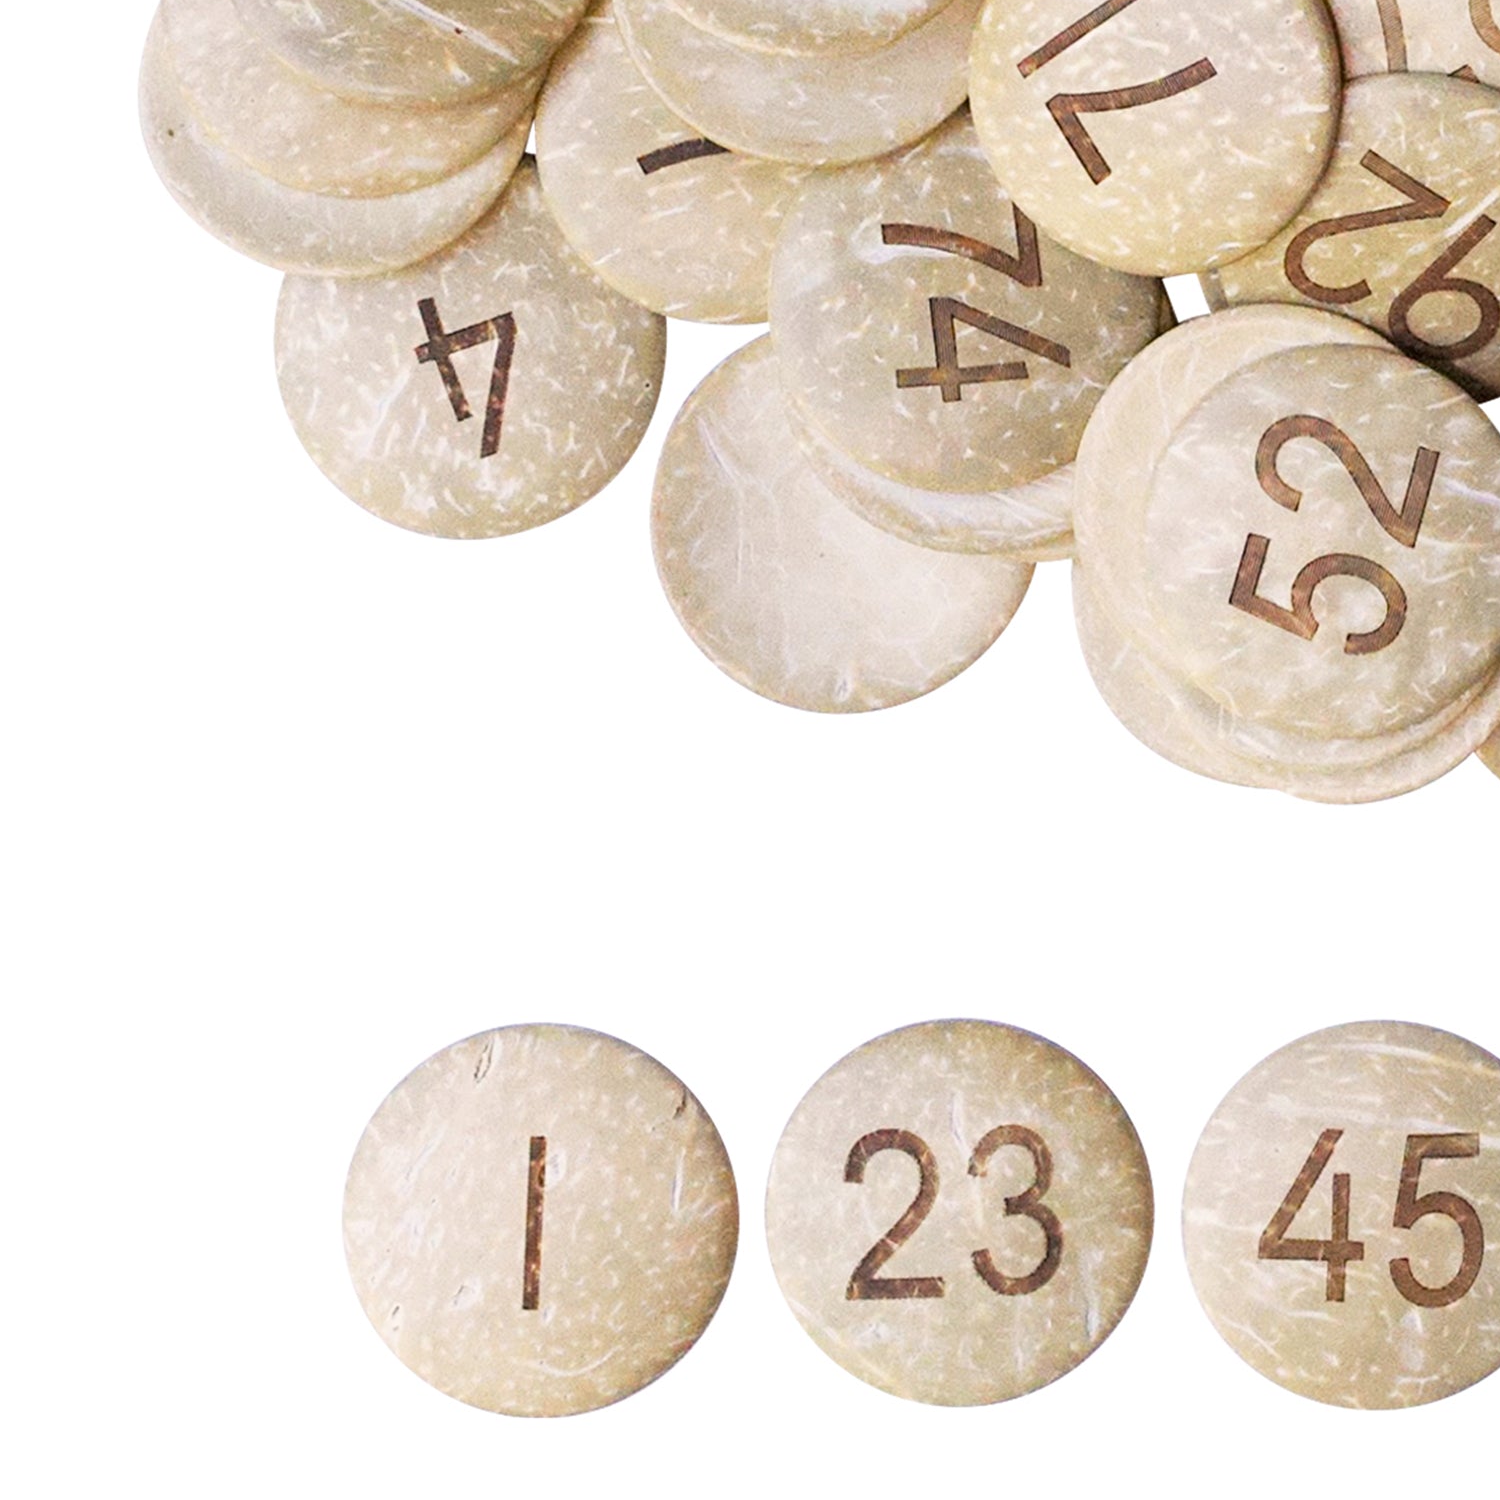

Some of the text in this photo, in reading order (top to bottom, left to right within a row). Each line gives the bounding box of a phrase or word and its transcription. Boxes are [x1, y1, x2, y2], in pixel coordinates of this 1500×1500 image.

[415, 297, 517, 458] 4
[880, 203, 1073, 403] 74
[1228, 414, 1441, 656] 52
[522, 1136, 546, 1311] 1
[844, 1124, 1065, 1300] 23
[1258, 1128, 1485, 1309] 45
